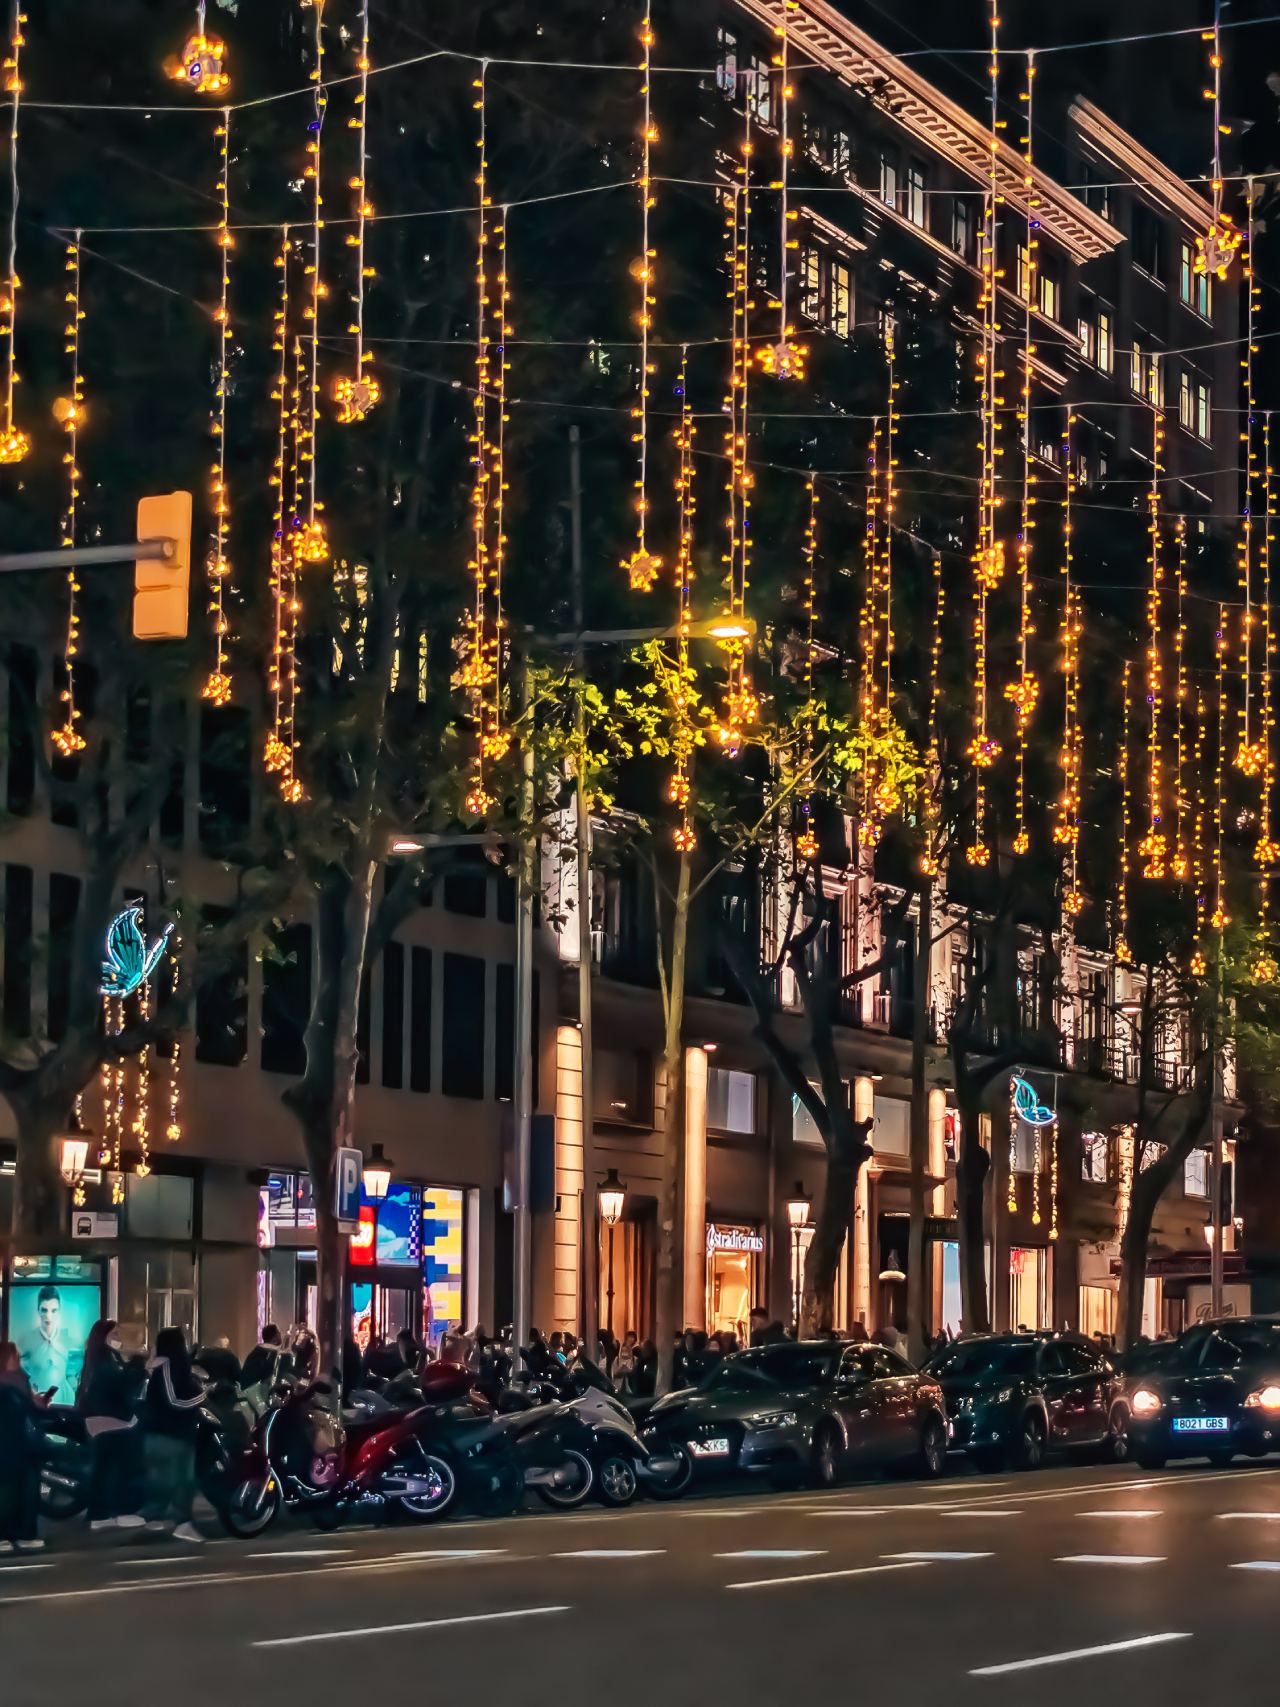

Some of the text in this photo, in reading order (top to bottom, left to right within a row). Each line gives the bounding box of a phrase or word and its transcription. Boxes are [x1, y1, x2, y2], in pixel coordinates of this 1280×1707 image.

[344, 1157, 358, 1211] P
[1179, 1418, 1224, 1429] 8021 GBS
